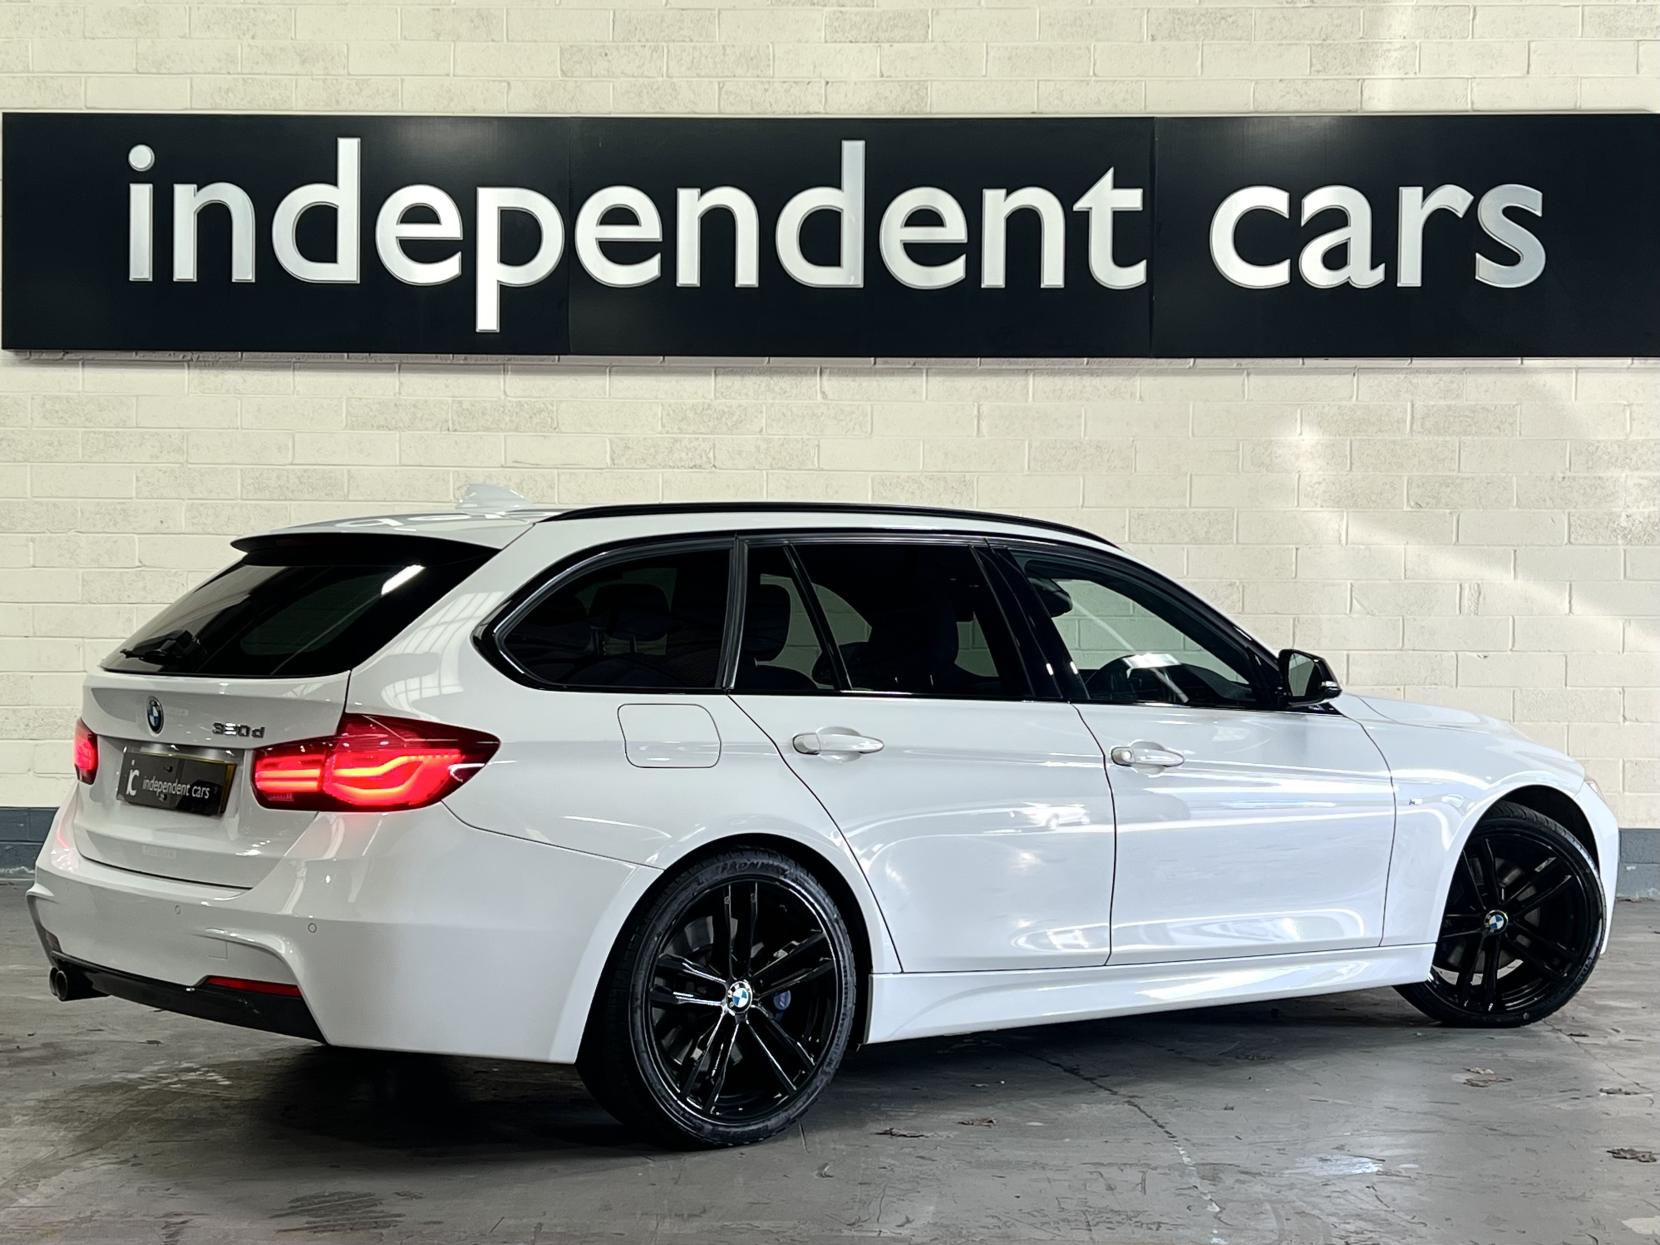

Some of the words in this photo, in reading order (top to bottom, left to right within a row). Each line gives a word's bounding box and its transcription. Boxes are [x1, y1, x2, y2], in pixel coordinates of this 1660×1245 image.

[128, 137, 1147, 333] independent
[1209, 184, 1546, 289] cars
[142, 775, 191, 797] independent
[191, 784, 211, 799] cars
